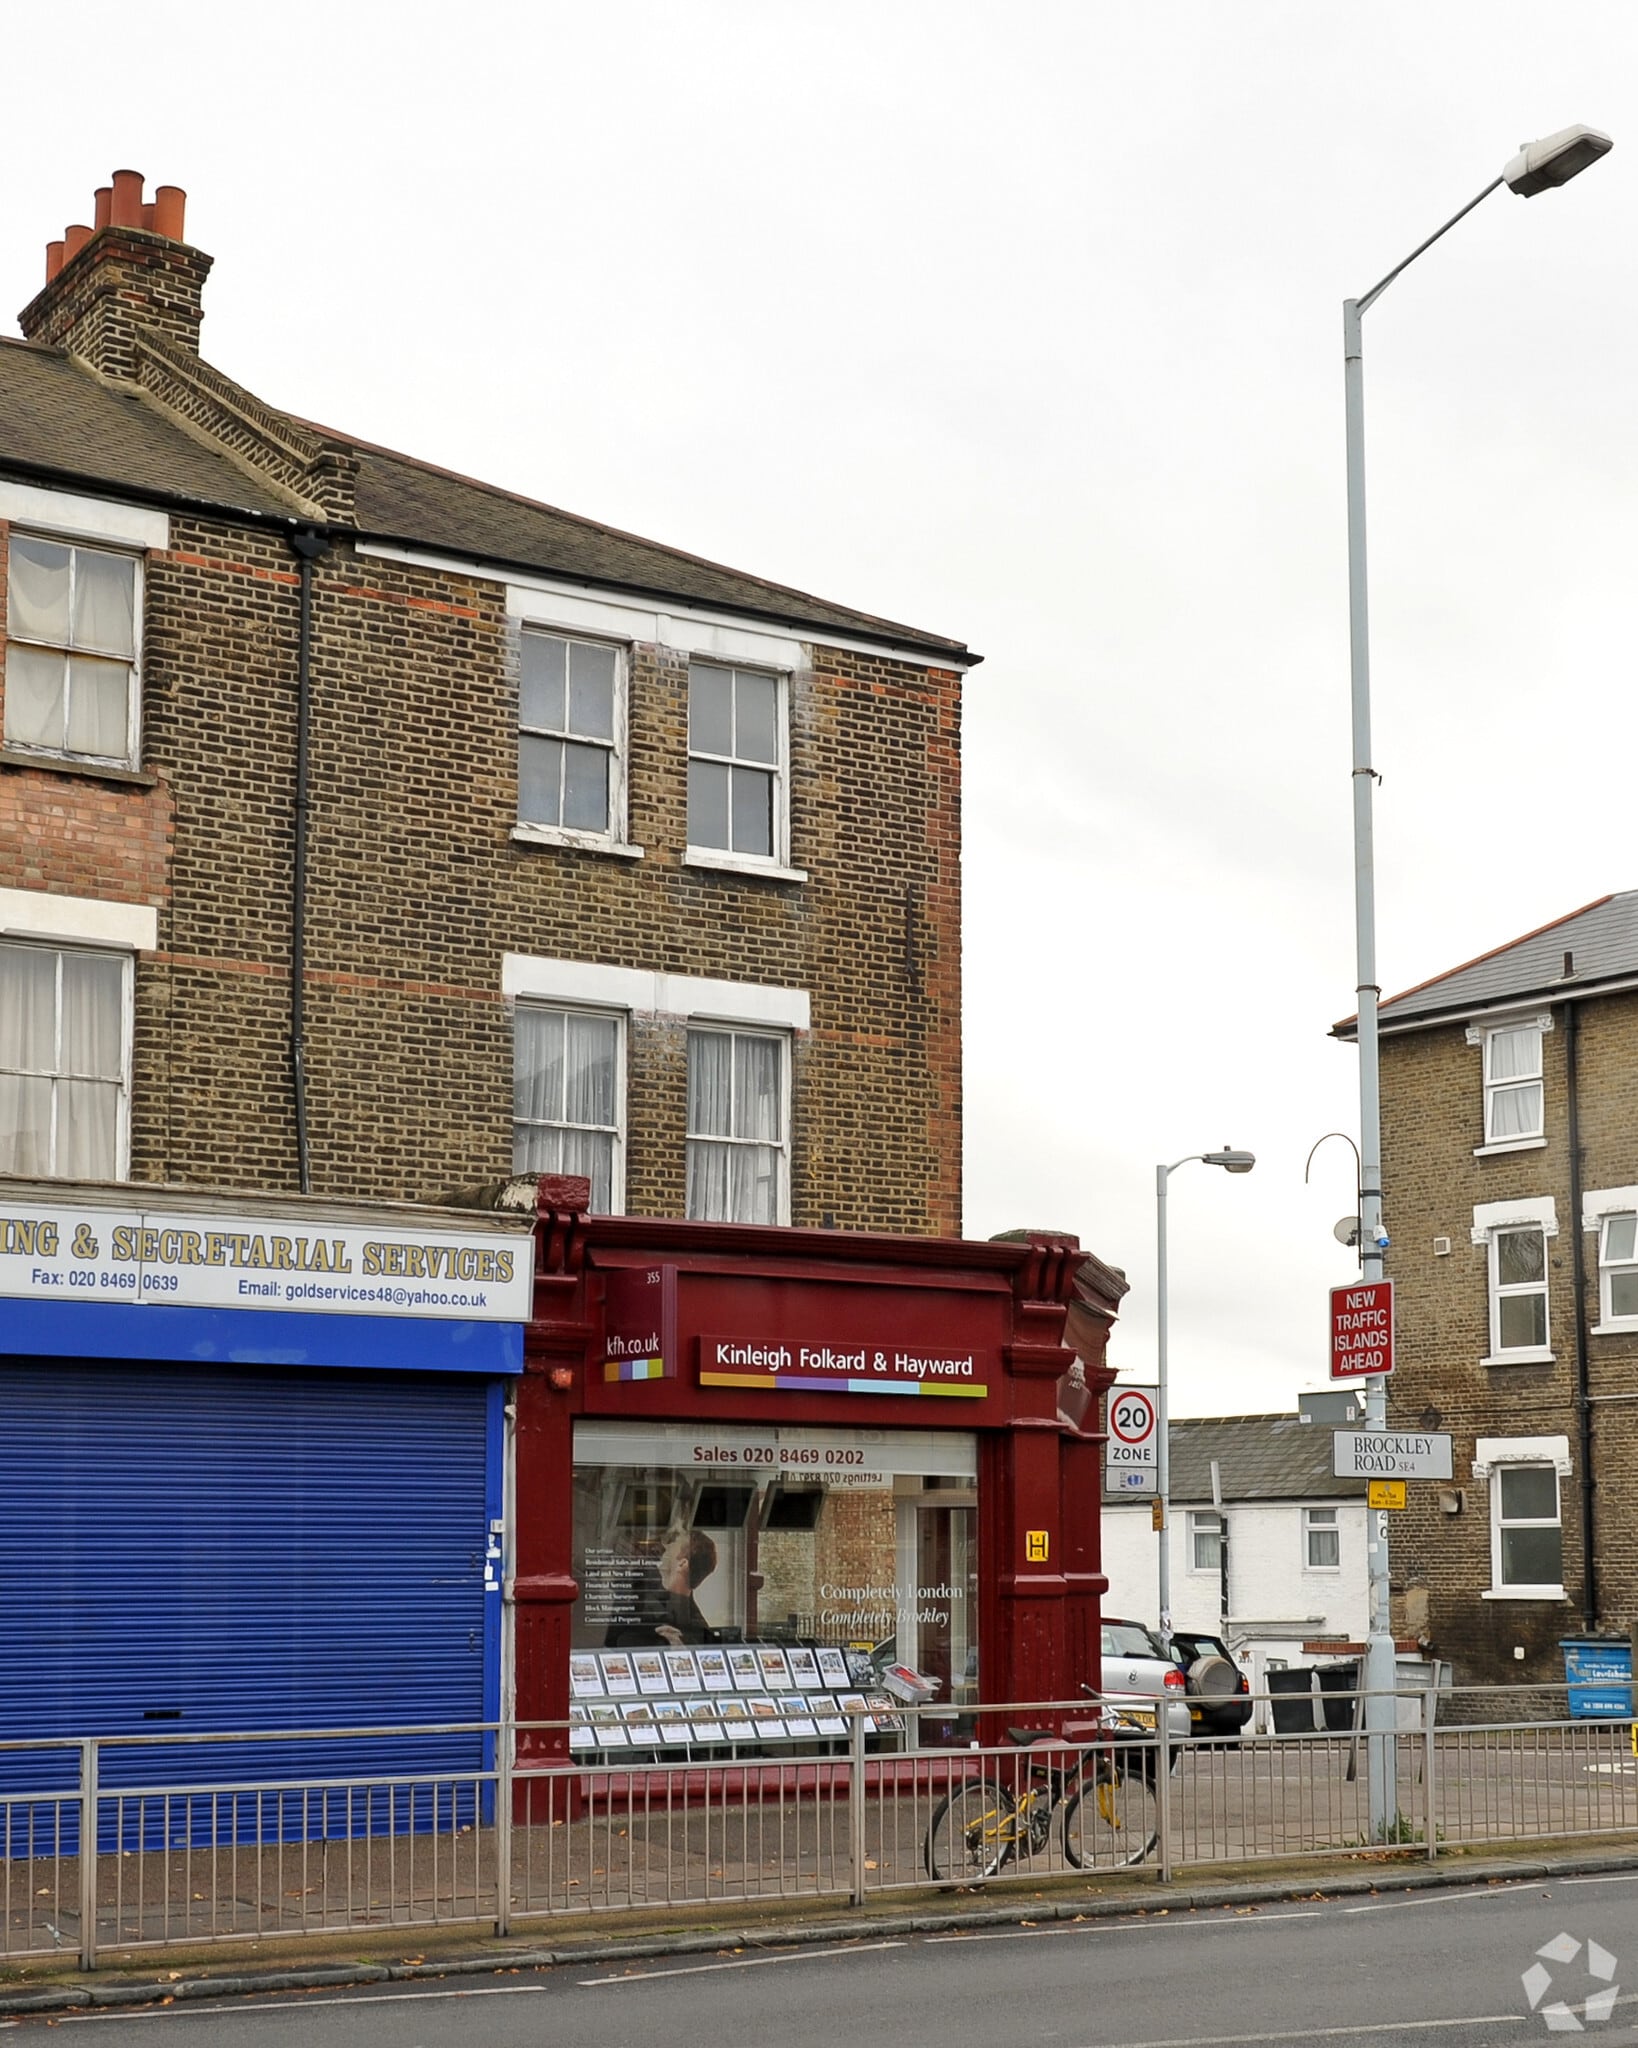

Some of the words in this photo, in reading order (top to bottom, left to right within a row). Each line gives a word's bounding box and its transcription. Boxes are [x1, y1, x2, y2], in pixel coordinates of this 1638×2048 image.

[71, 1223, 99, 1260] &
[112, 1225, 353, 1274] SECRETARIAL
[363, 1241, 514, 1284] SERVICES
[32, 1268, 64, 1285] Fax:
[69, 1270, 96, 1287] 020
[100, 1272, 136, 1289] 8469
[143, 1274, 178, 1291] 0639
[646, 1271, 660, 1285] 355
[238, 1279, 281, 1297] Email:
[285, 1282, 487, 1308] goldservices48@yahoo.co.uk
[1346, 1290, 1376, 1309] NEW
[1336, 1309, 1387, 1331] TRAFFIC
[607, 1331, 660, 1356] kfh.co.uk
[1334, 1329, 1388, 1352] ISLANDS
[716, 1343, 792, 1371] Kinleigh
[799, 1347, 866, 1371] Folkard
[873, 1352, 887, 1372] &
[894, 1353, 973, 1378] Hayward
[1340, 1350, 1384, 1371] AHEAD
[1118, 1407, 1147, 1428] 20
[693, 1446, 738, 1463] Sales
[743, 1447, 774, 1463] 020
[780, 1448, 819, 1464] 8469
[825, 1449, 865, 1465] 0202
[1113, 1447, 1151, 1460] ZONE
[1354, 1436, 1434, 1455] BROCKLEY
[1354, 1455, 1396, 1471] ROAD
[1399, 1461, 1415, 1472] SE4
[820, 1583, 903, 1605] Completely
[908, 1582, 963, 1599] London
[820, 1608, 892, 1630] Completely
